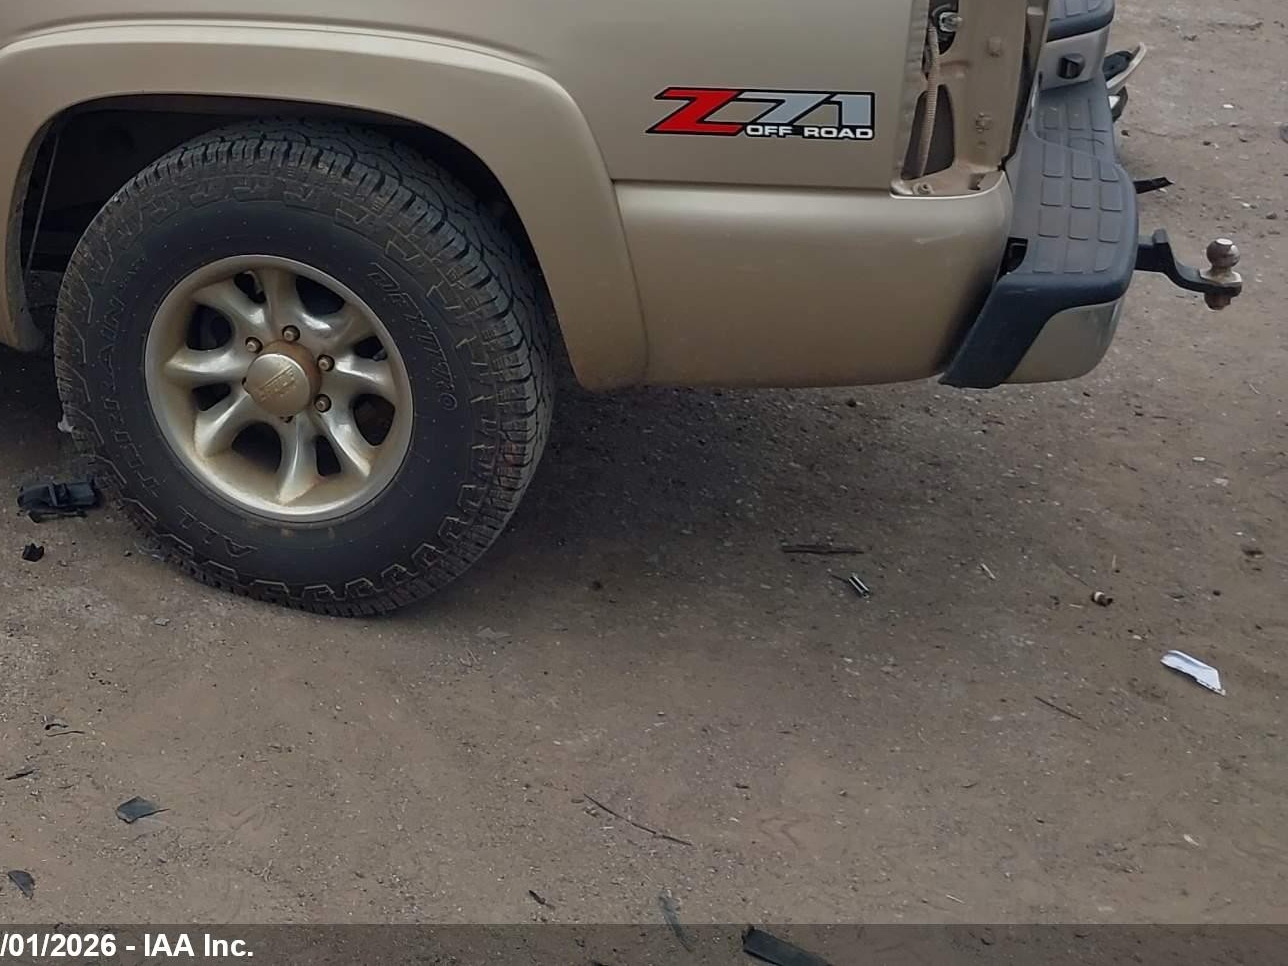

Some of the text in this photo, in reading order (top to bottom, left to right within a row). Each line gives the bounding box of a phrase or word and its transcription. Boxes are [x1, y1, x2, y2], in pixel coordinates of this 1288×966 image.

[645, 87, 875, 136] Z71
[745, 125, 874, 140] OFF ROAD
